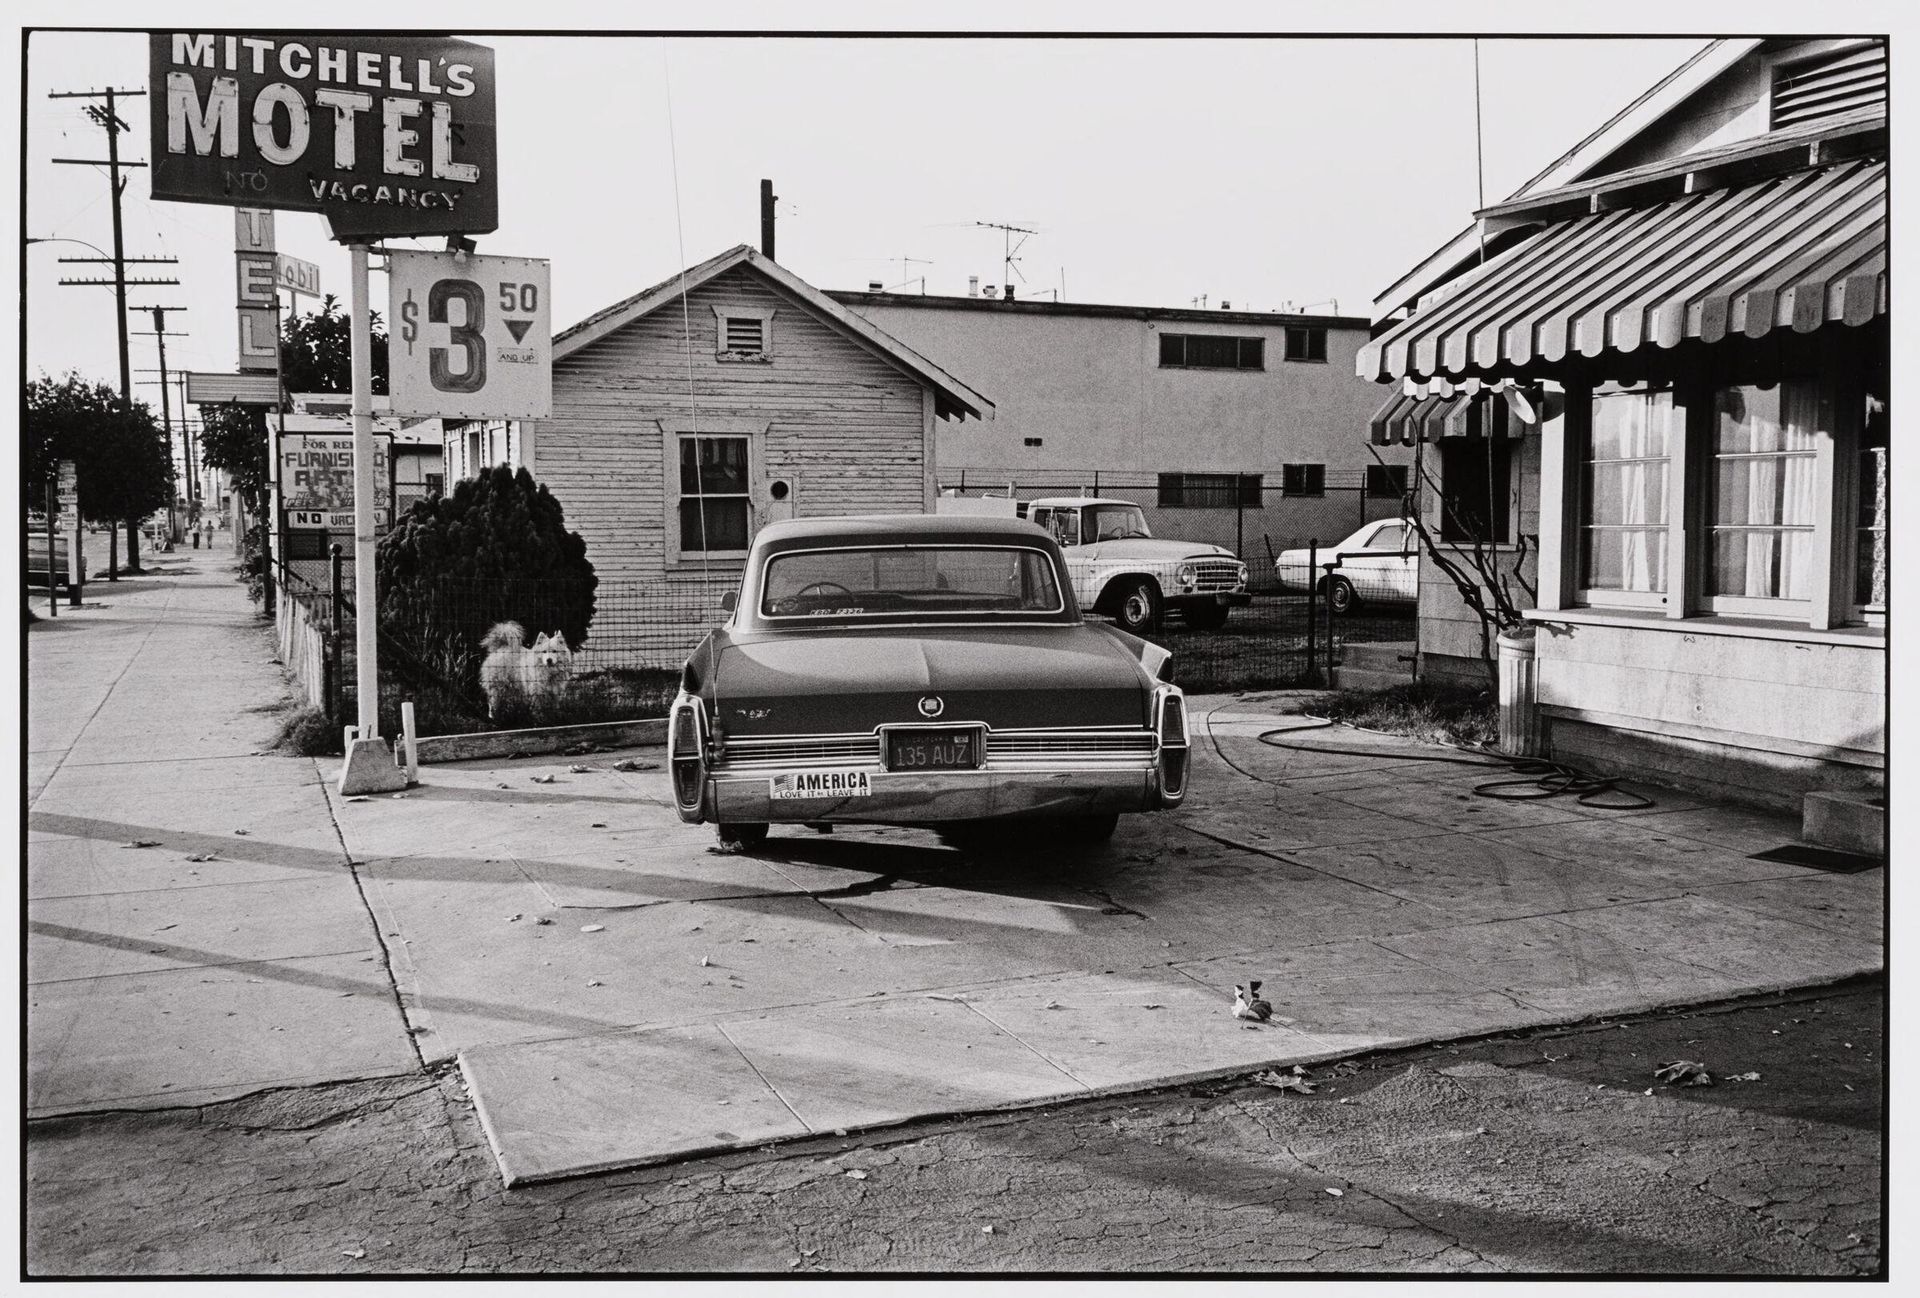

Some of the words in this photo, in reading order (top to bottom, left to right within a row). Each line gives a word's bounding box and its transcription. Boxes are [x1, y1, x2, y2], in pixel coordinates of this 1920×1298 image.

[172, 33, 476, 97] MITCHELL'S
[167, 71, 480, 183] MOTEL
[226, 169, 268, 192] NO
[309, 179, 460, 211] VACANCY
[499, 282, 538, 313] 50
[500, 353, 518, 361] AND
[522, 354, 535, 362] UP
[303, 441, 327, 449] FOR
[297, 513, 322, 524] NO
[896, 746, 926, 766] 135
[933, 744, 967, 764] AUZ
[797, 772, 868, 790] AMERICA
[780, 791, 803, 799] LOVE
[807, 790, 815, 798] IT
[827, 788, 854, 797] LEAVE
[860, 788, 868, 796] IT
